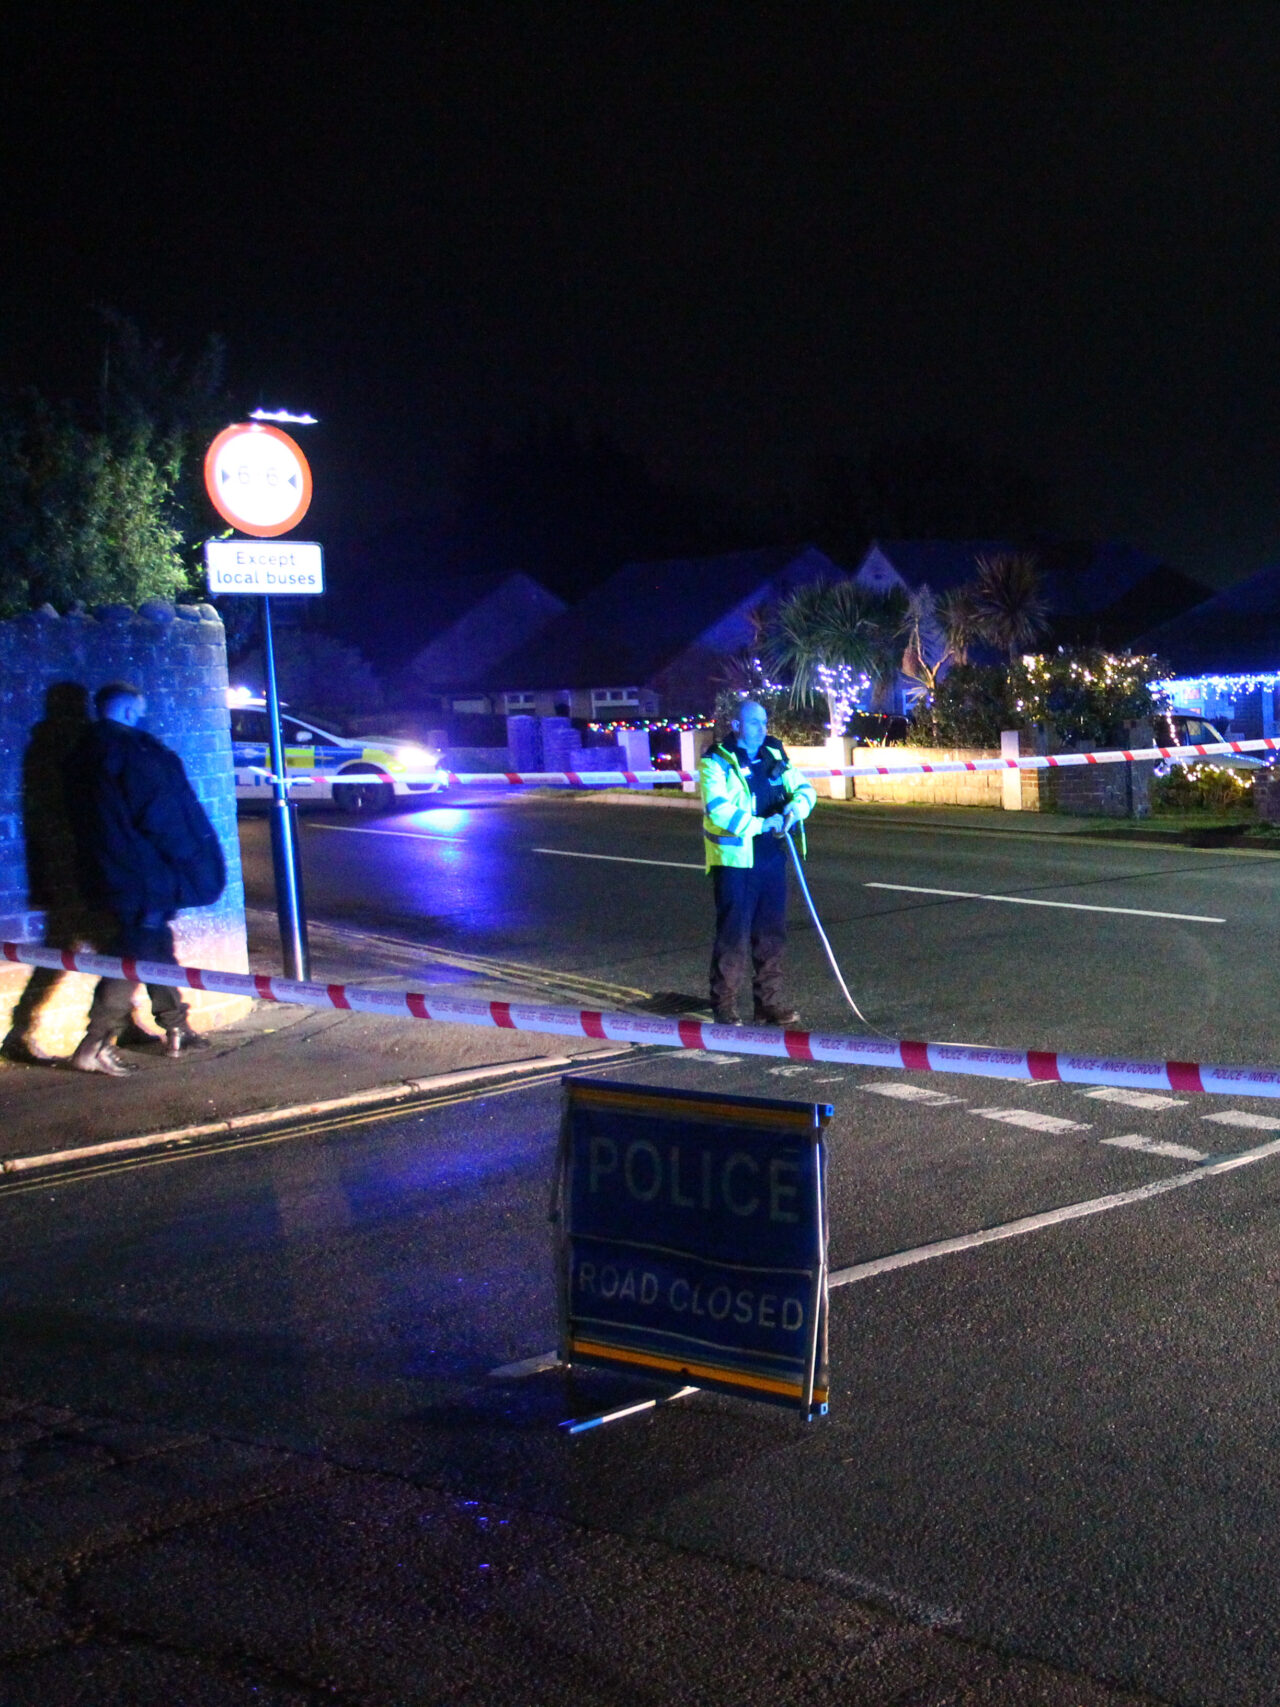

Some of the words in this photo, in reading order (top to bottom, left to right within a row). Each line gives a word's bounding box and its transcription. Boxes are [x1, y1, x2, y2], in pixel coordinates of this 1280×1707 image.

[236, 552, 296, 567] Except
[217, 571, 259, 584] local
[266, 571, 316, 585] buses
[1212, 1068, 1242, 1080] POLICE
[588, 1136, 800, 1224] POLICE
[579, 1262, 659, 1305] ROAD
[670, 1279, 804, 1332] CLOSED
